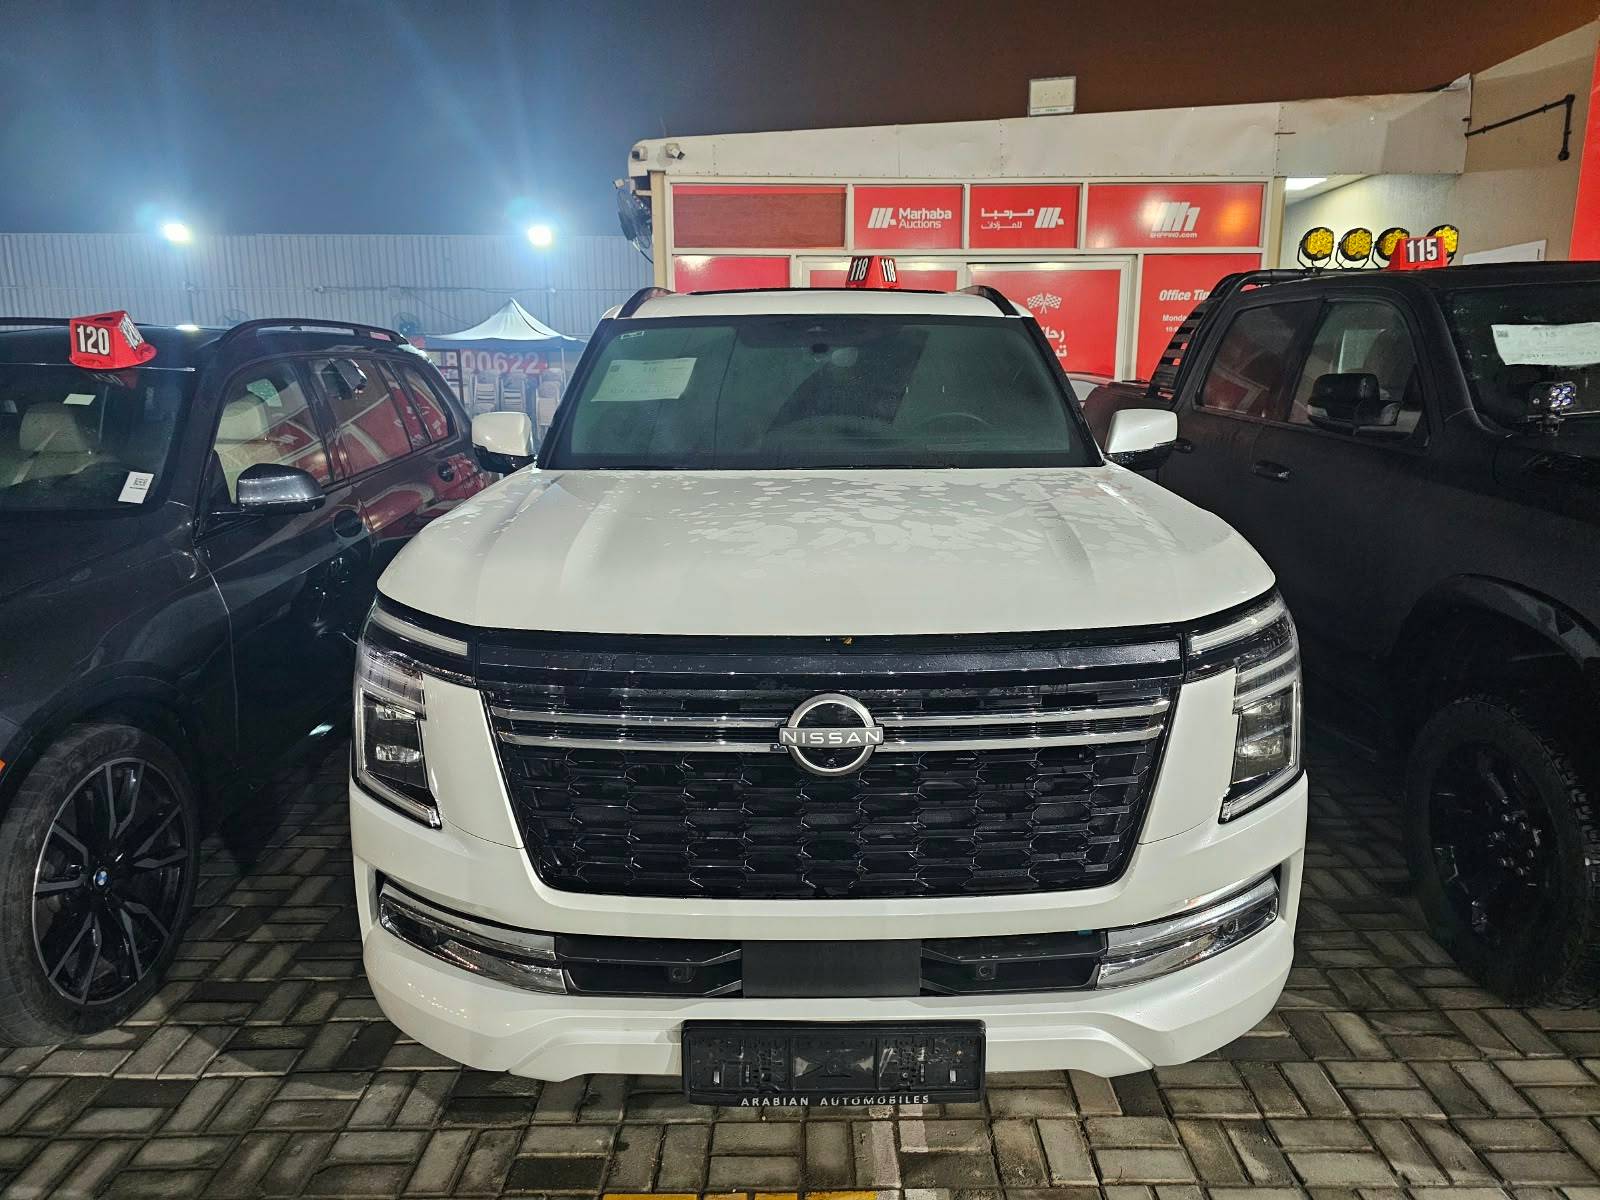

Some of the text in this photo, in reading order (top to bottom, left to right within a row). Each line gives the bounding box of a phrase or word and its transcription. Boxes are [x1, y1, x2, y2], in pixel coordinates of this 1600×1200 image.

[899, 207, 952, 220] Marhaba
[981, 207, 1035, 220] مرحبا
[899, 219, 942, 229] Auctions
[1407, 238, 1438, 263] 115
[850, 257, 869, 281] 118
[880, 258, 897, 282] 118
[1159, 289, 1192, 301] Office
[77, 325, 110, 355] 120
[781, 730, 881, 745] NISSAN
[740, 1094, 930, 1107] ARABIAN AUTOMOBILES
